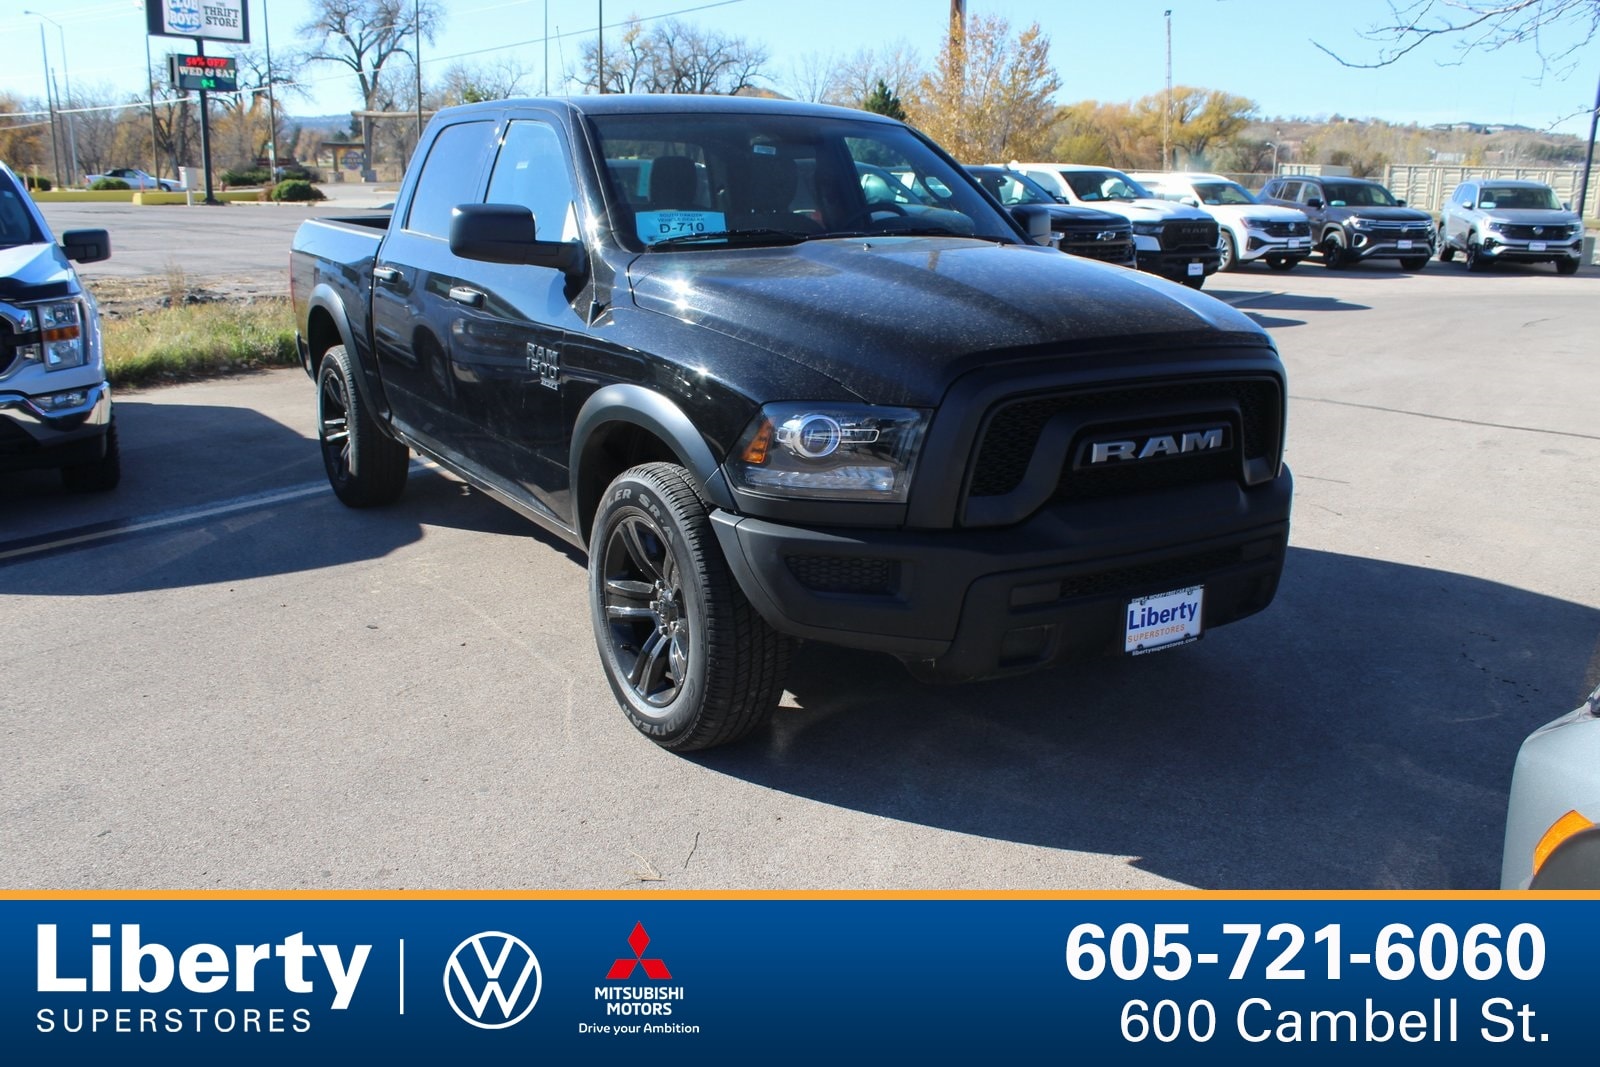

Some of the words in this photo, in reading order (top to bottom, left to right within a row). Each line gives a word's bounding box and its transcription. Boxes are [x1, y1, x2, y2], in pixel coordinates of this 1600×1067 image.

[169, 10, 201, 26] BOYS
[203, 5, 240, 18] THRIFT
[205, 16, 238, 28] STORE
[206, 57, 229, 68] OFF
[179, 66, 204, 77] WED
[204, 68, 215, 78] &
[215, 69, 236, 79] SAT
[659, 222, 705, 234] D-710
[526, 342, 559, 366] RAM
[526, 357, 560, 380] 1500
[1091, 428, 1223, 464] RAM
[1128, 602, 1198, 630] Liberty
[1127, 624, 1185, 643] SUPERSTORES
